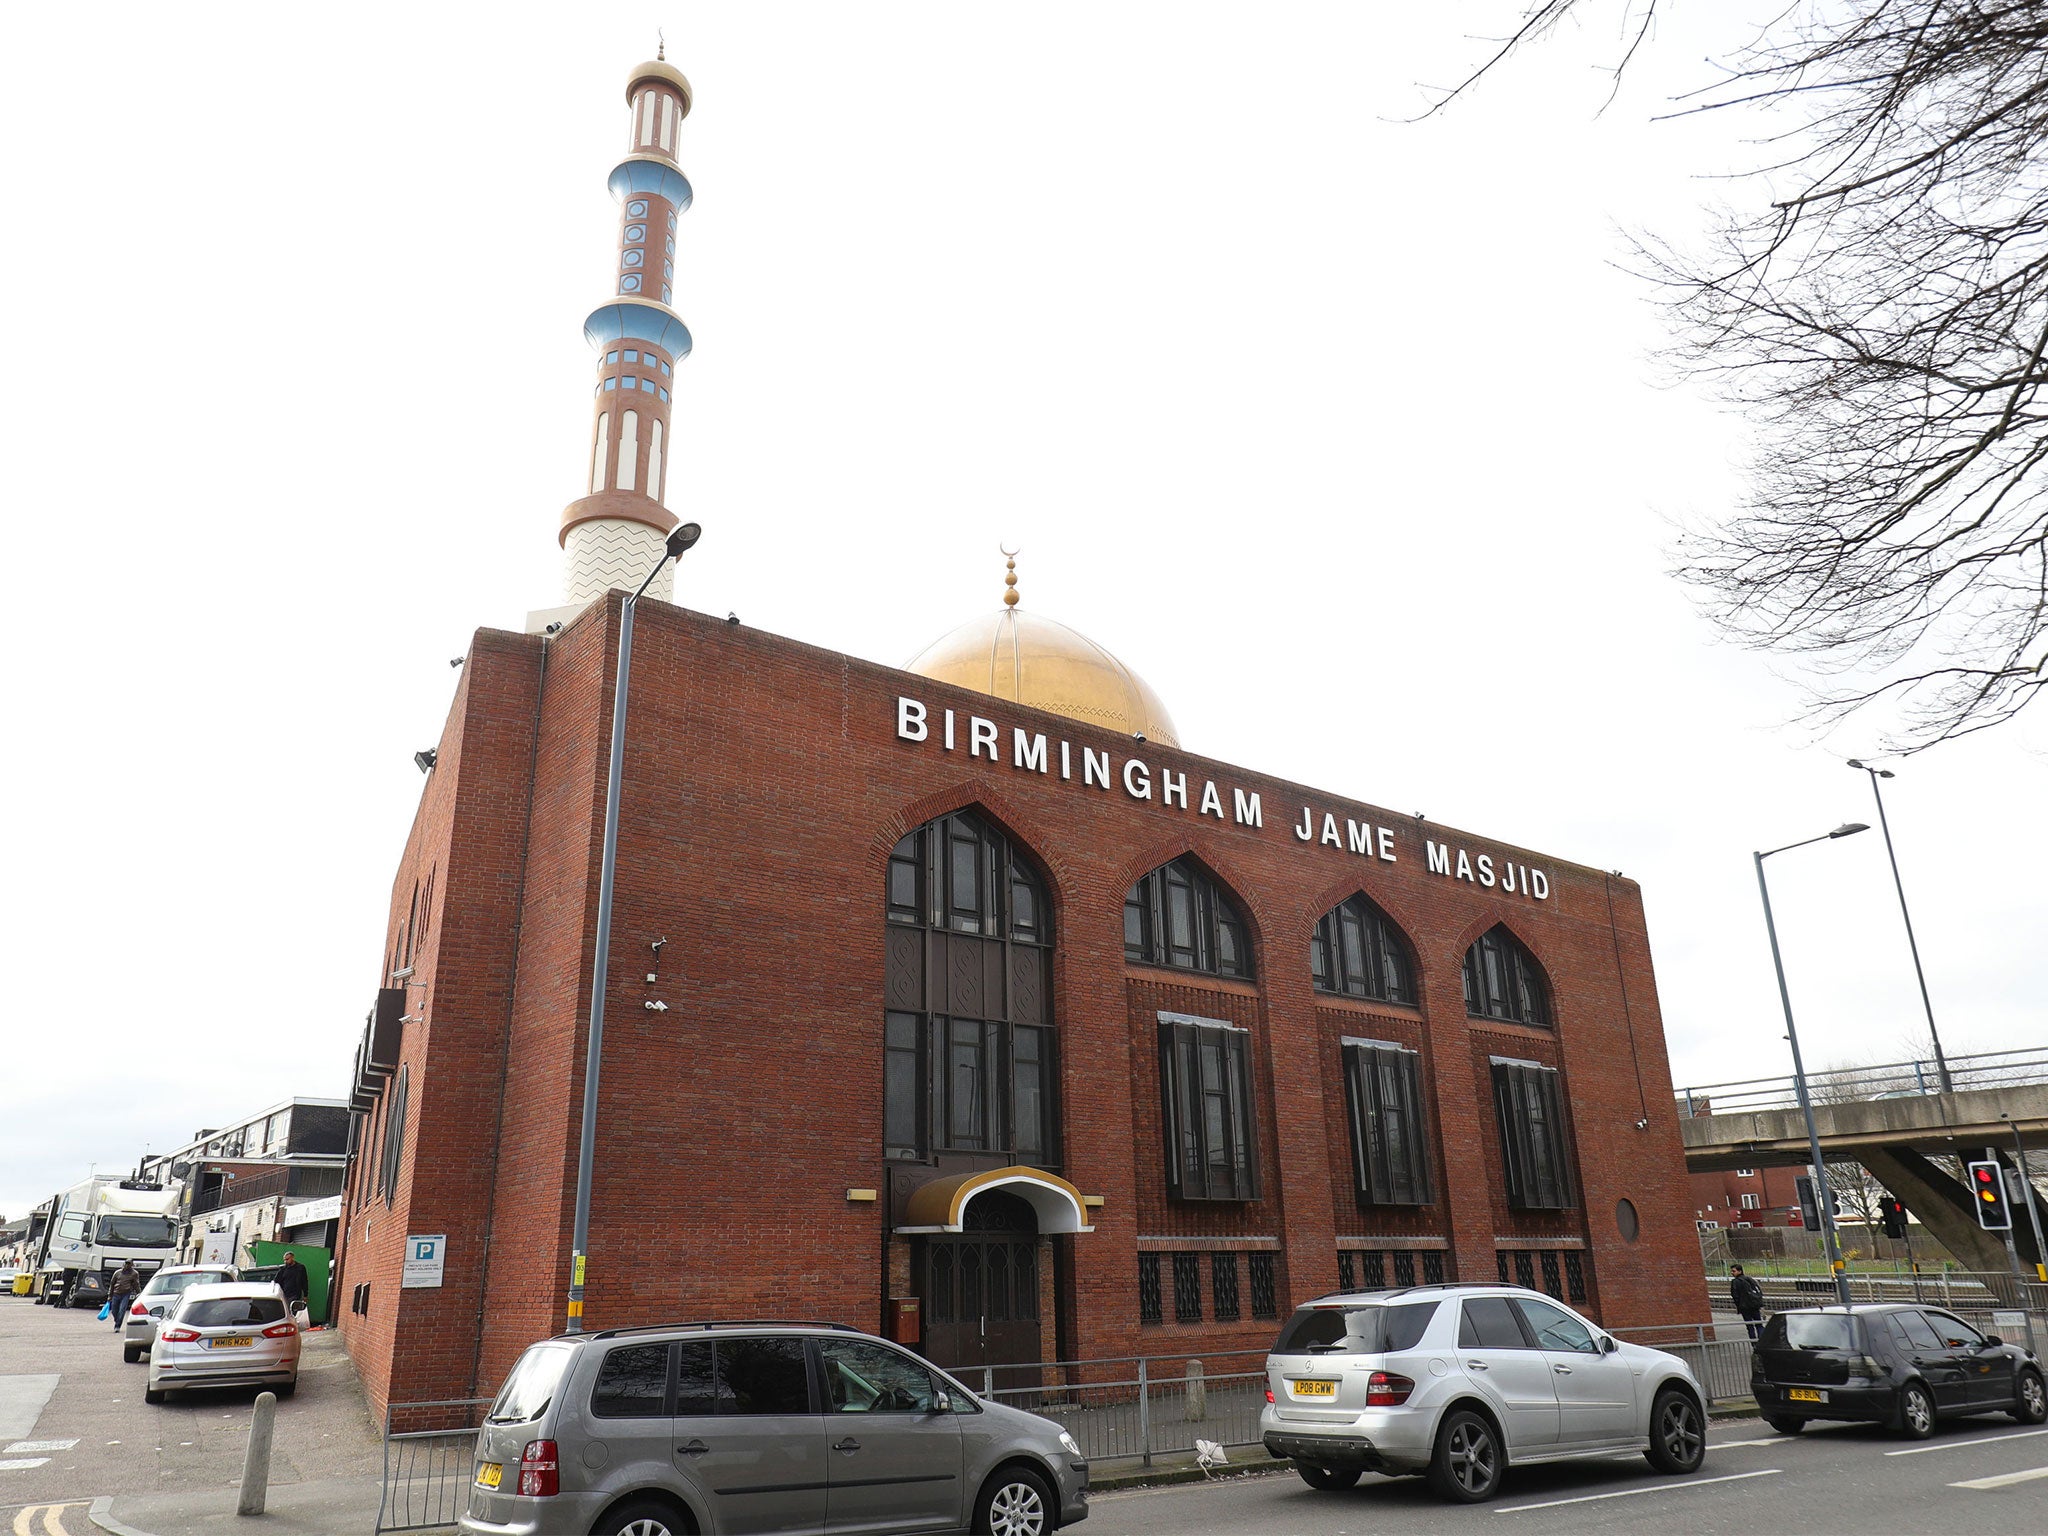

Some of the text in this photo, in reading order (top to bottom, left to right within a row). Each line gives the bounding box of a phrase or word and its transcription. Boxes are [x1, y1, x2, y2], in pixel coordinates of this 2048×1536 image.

[898, 696, 1549, 900] BIRMINGHAM JAME MASJID
[419, 1244, 432, 1258] P
[576, 1264, 585, 1272] 03
[1295, 1380, 1331, 1393] LP08 GWW
